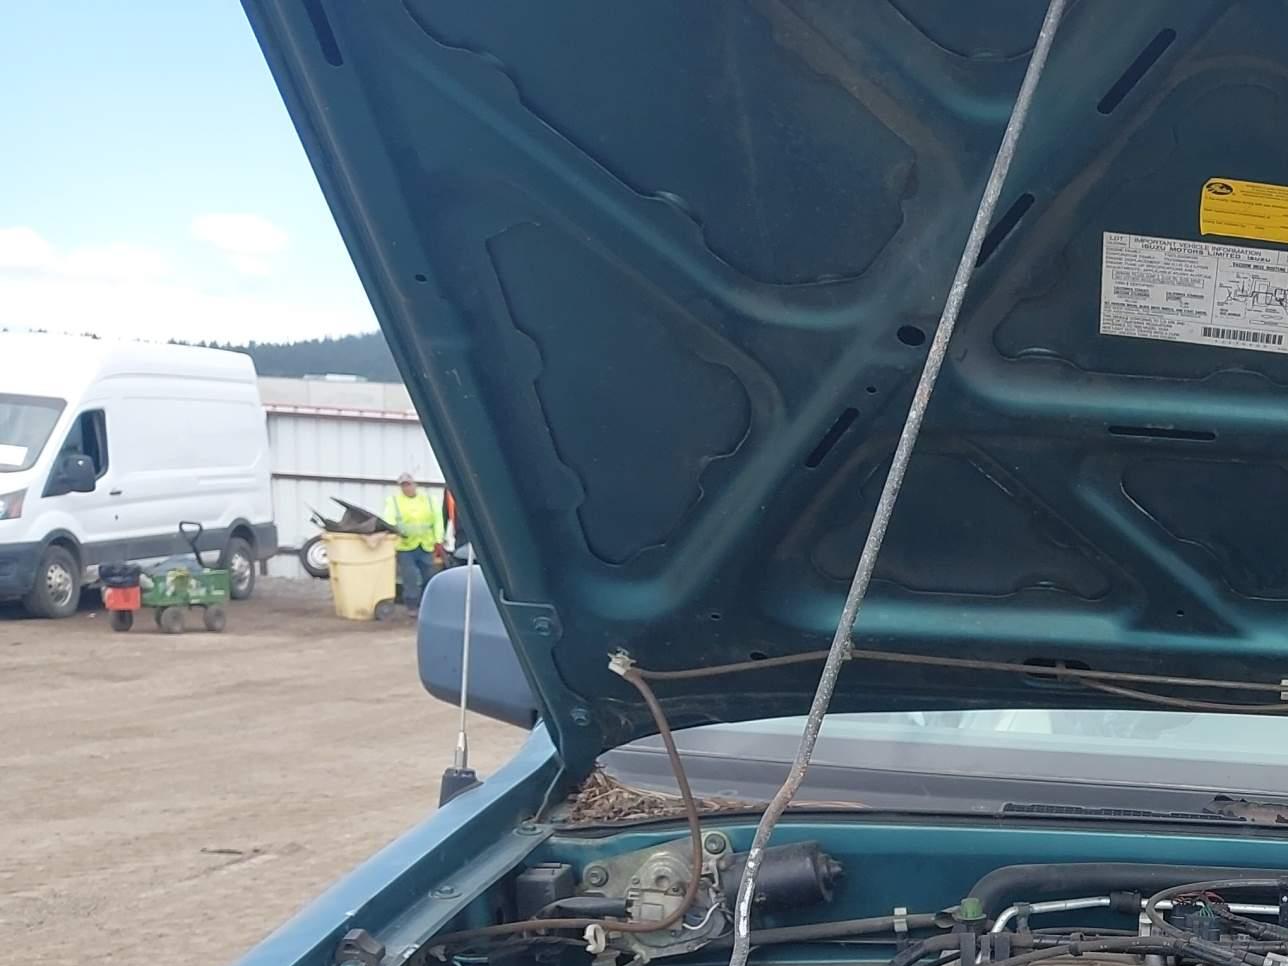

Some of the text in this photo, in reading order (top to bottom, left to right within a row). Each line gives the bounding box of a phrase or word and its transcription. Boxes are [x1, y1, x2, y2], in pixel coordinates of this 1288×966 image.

[1134, 238, 1176, 247] IMPORTANT
[1179, 242, 1208, 251] VEHICLE
[1211, 246, 1262, 257] INFORMATION
[1141, 243, 1166, 251] ISUZU
[1169, 247, 1204, 255] MOTORS
[1207, 250, 1241, 259] LIMITED
